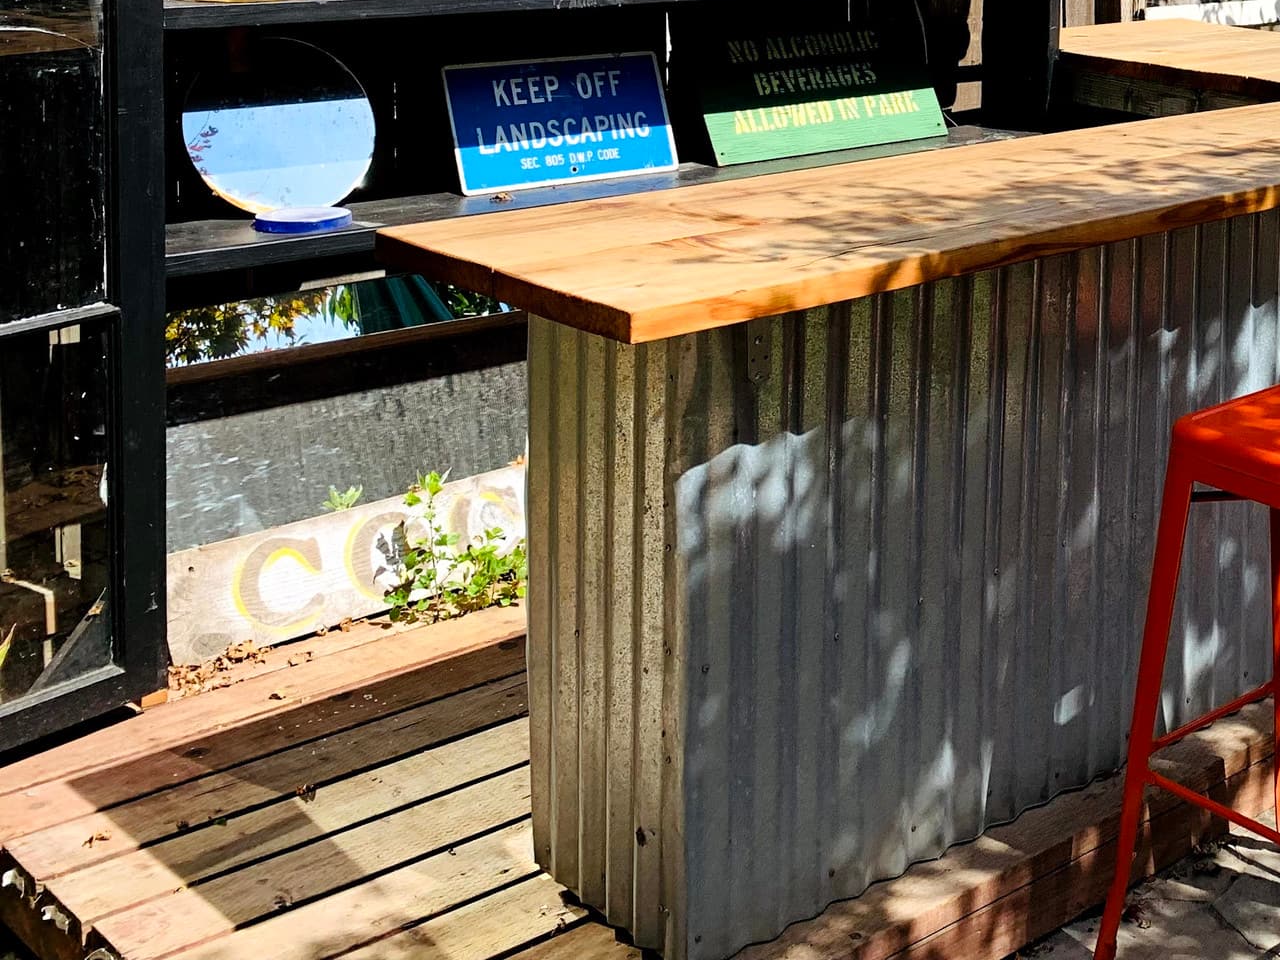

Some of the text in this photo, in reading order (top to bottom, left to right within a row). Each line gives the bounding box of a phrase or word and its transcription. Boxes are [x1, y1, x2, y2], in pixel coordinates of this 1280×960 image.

[727, 30, 879, 64] NO ALCOHOLIC
[492, 70, 621, 107] KEEP OFF
[753, 62, 877, 96] BEVERAGES
[735, 90, 920, 135] ALLOWED IN PARK
[476, 111, 650, 155] LANDSCAPING
[545, 153, 565, 166] 805
[597, 148, 621, 161] CODE
